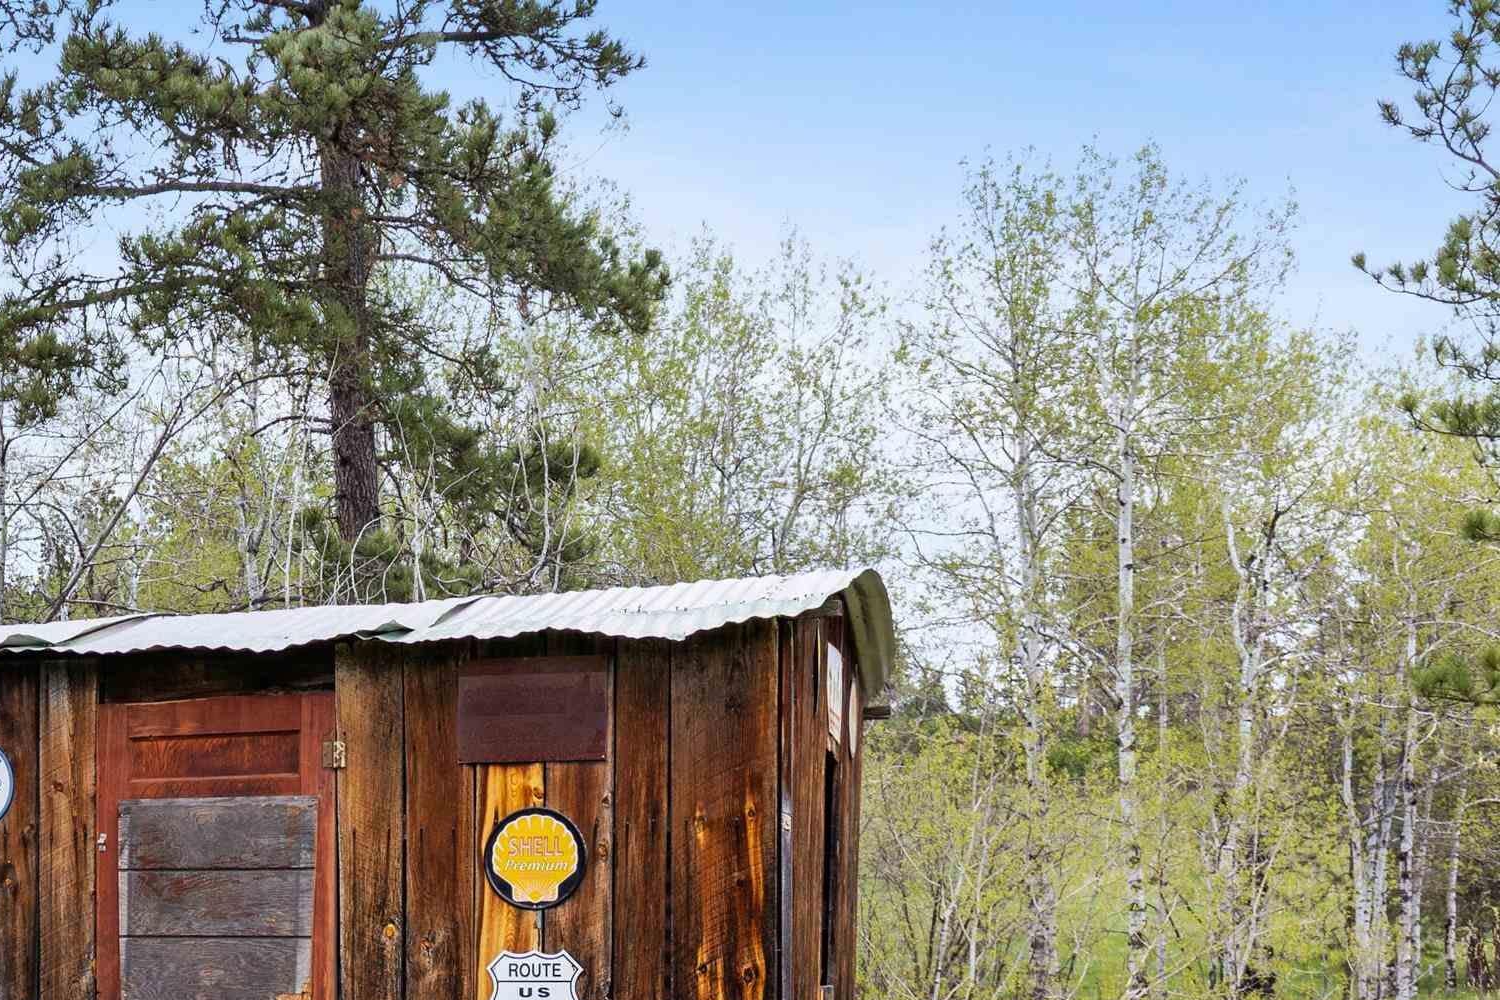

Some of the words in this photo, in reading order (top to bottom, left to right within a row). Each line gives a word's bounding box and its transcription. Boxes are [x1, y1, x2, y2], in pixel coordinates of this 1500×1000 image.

[507, 835, 565, 858] SHELL
[504, 858, 569, 872] Premium
[508, 962, 562, 978] ROUTE
[518, 986, 551, 999] US
